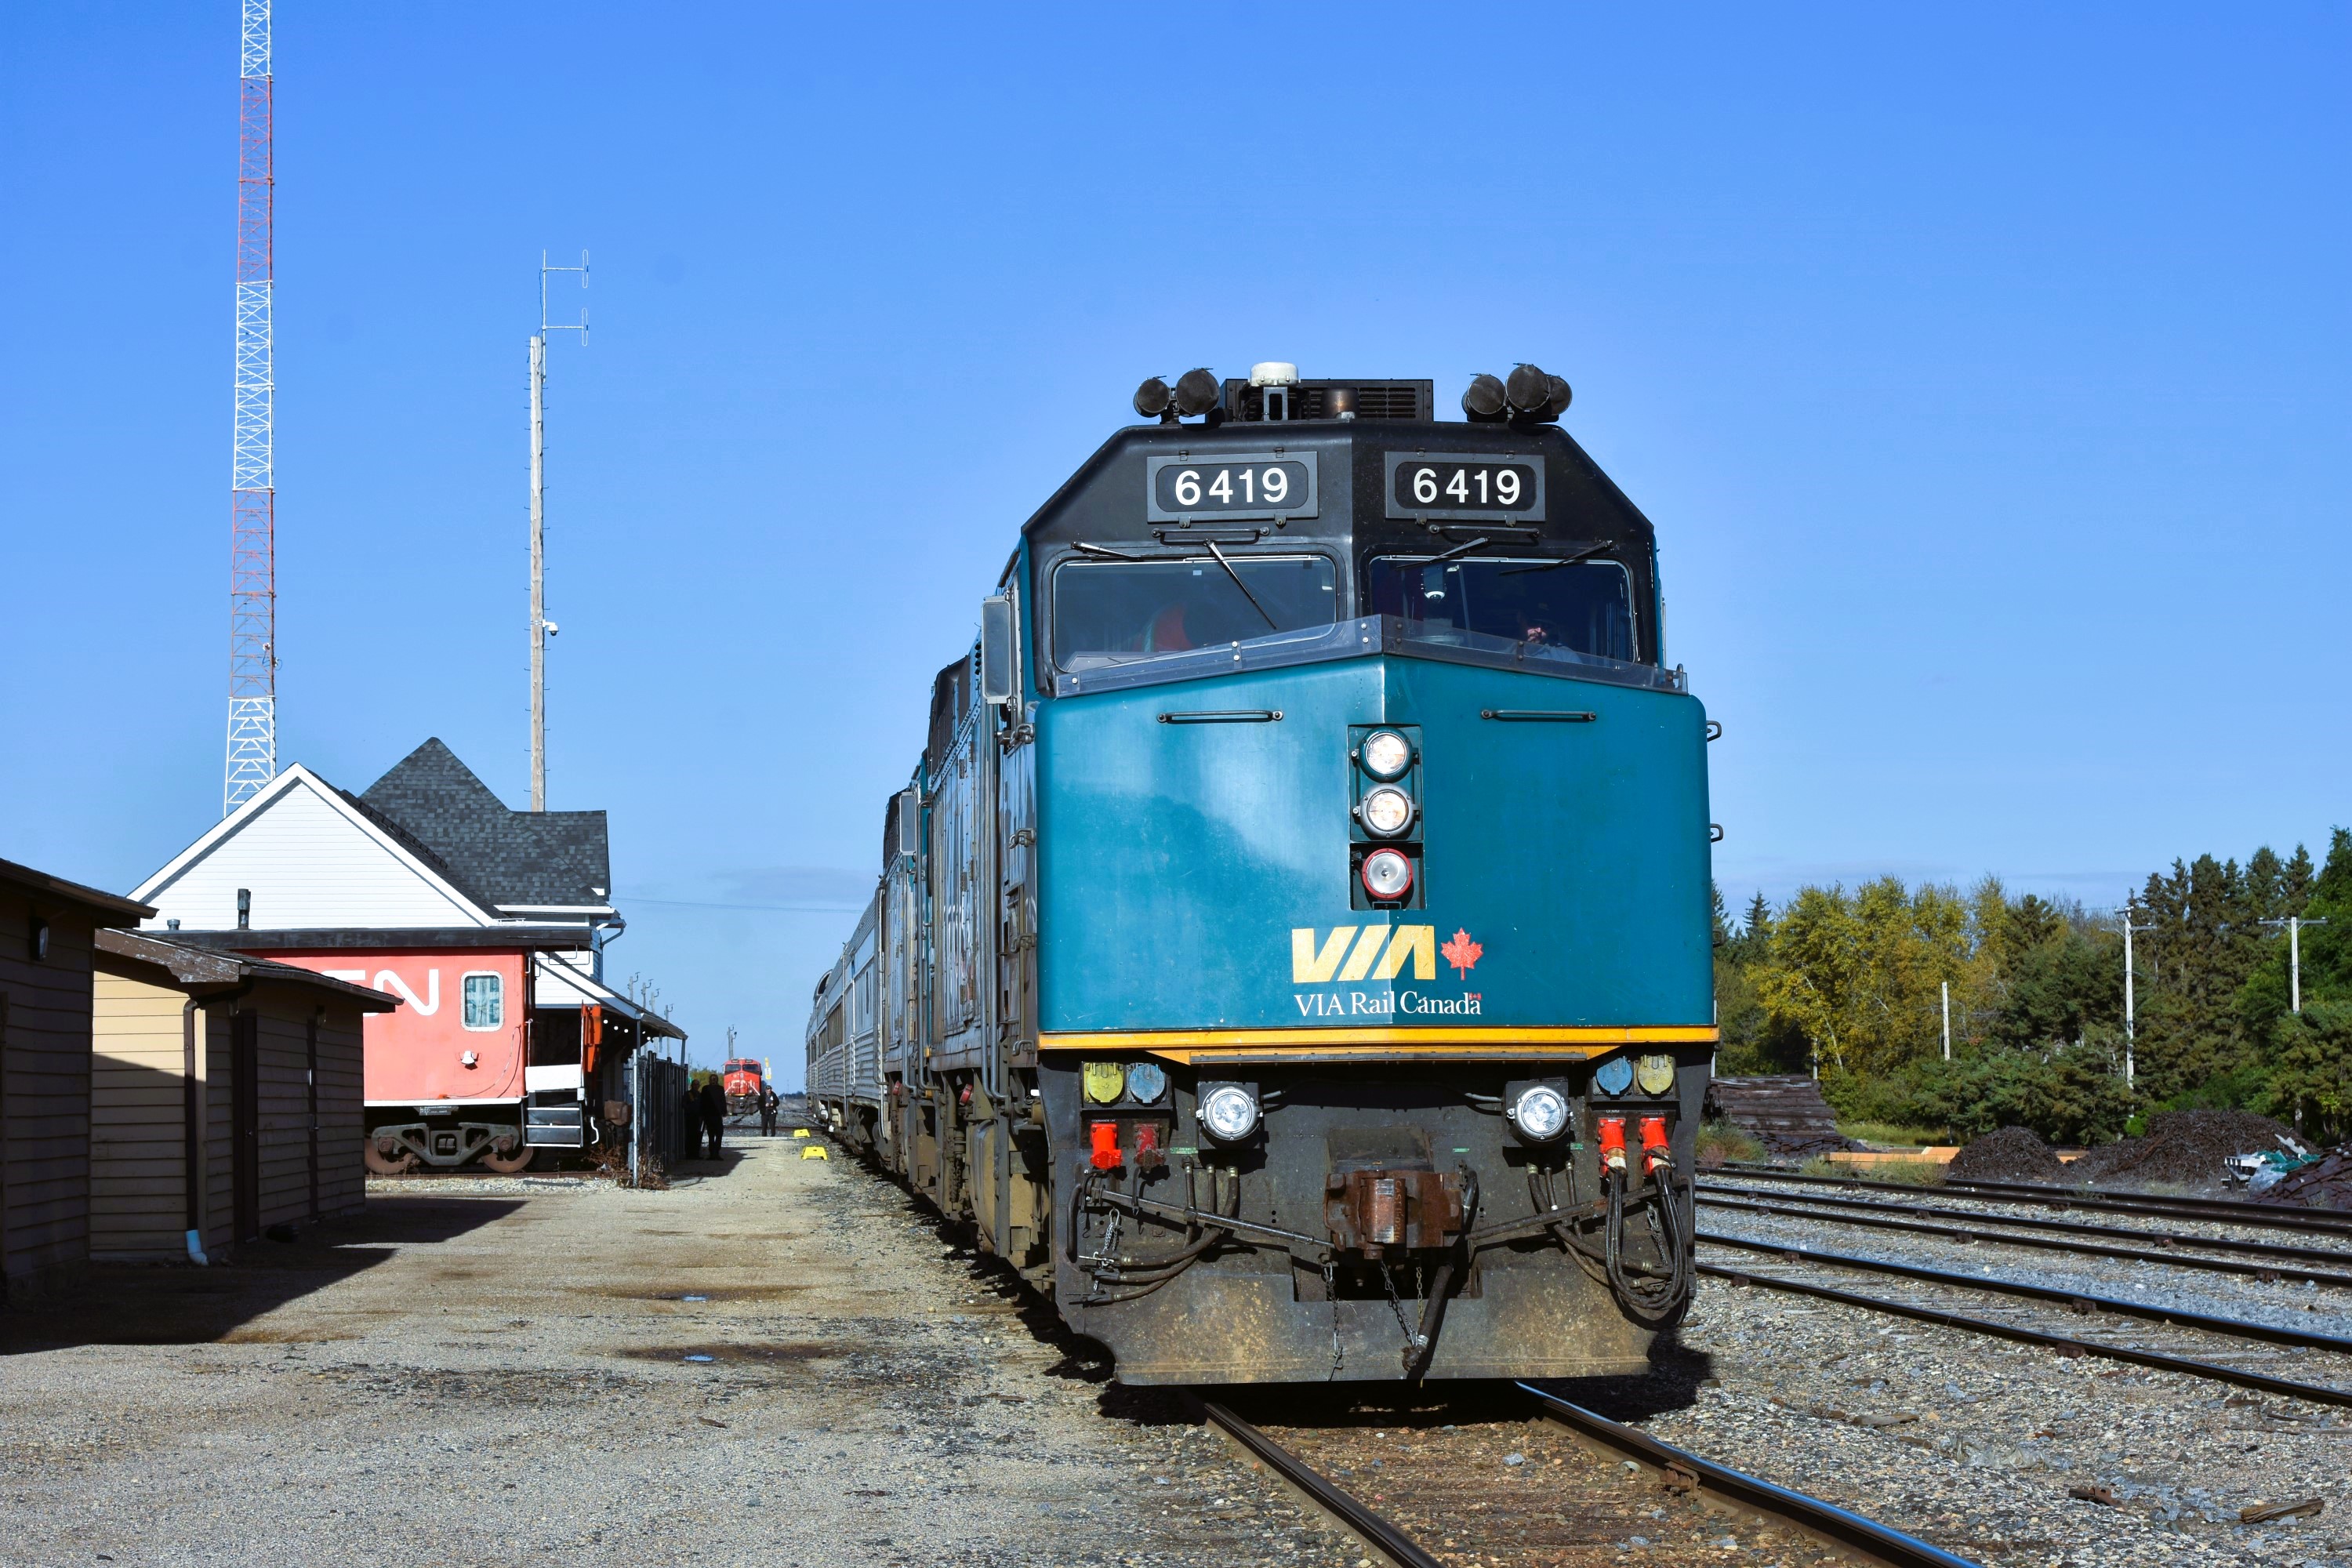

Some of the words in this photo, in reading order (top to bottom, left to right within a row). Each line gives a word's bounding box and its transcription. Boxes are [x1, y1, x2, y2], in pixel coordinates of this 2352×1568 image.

[1175, 467, 1288, 506] 6419
[1414, 468, 1521, 505] 6419
[1292, 924, 1436, 983] VIA
[1294, 993, 1345, 1017] VIA
[1350, 990, 1396, 1015] Rail
[1399, 991, 1482, 1015] Canada
